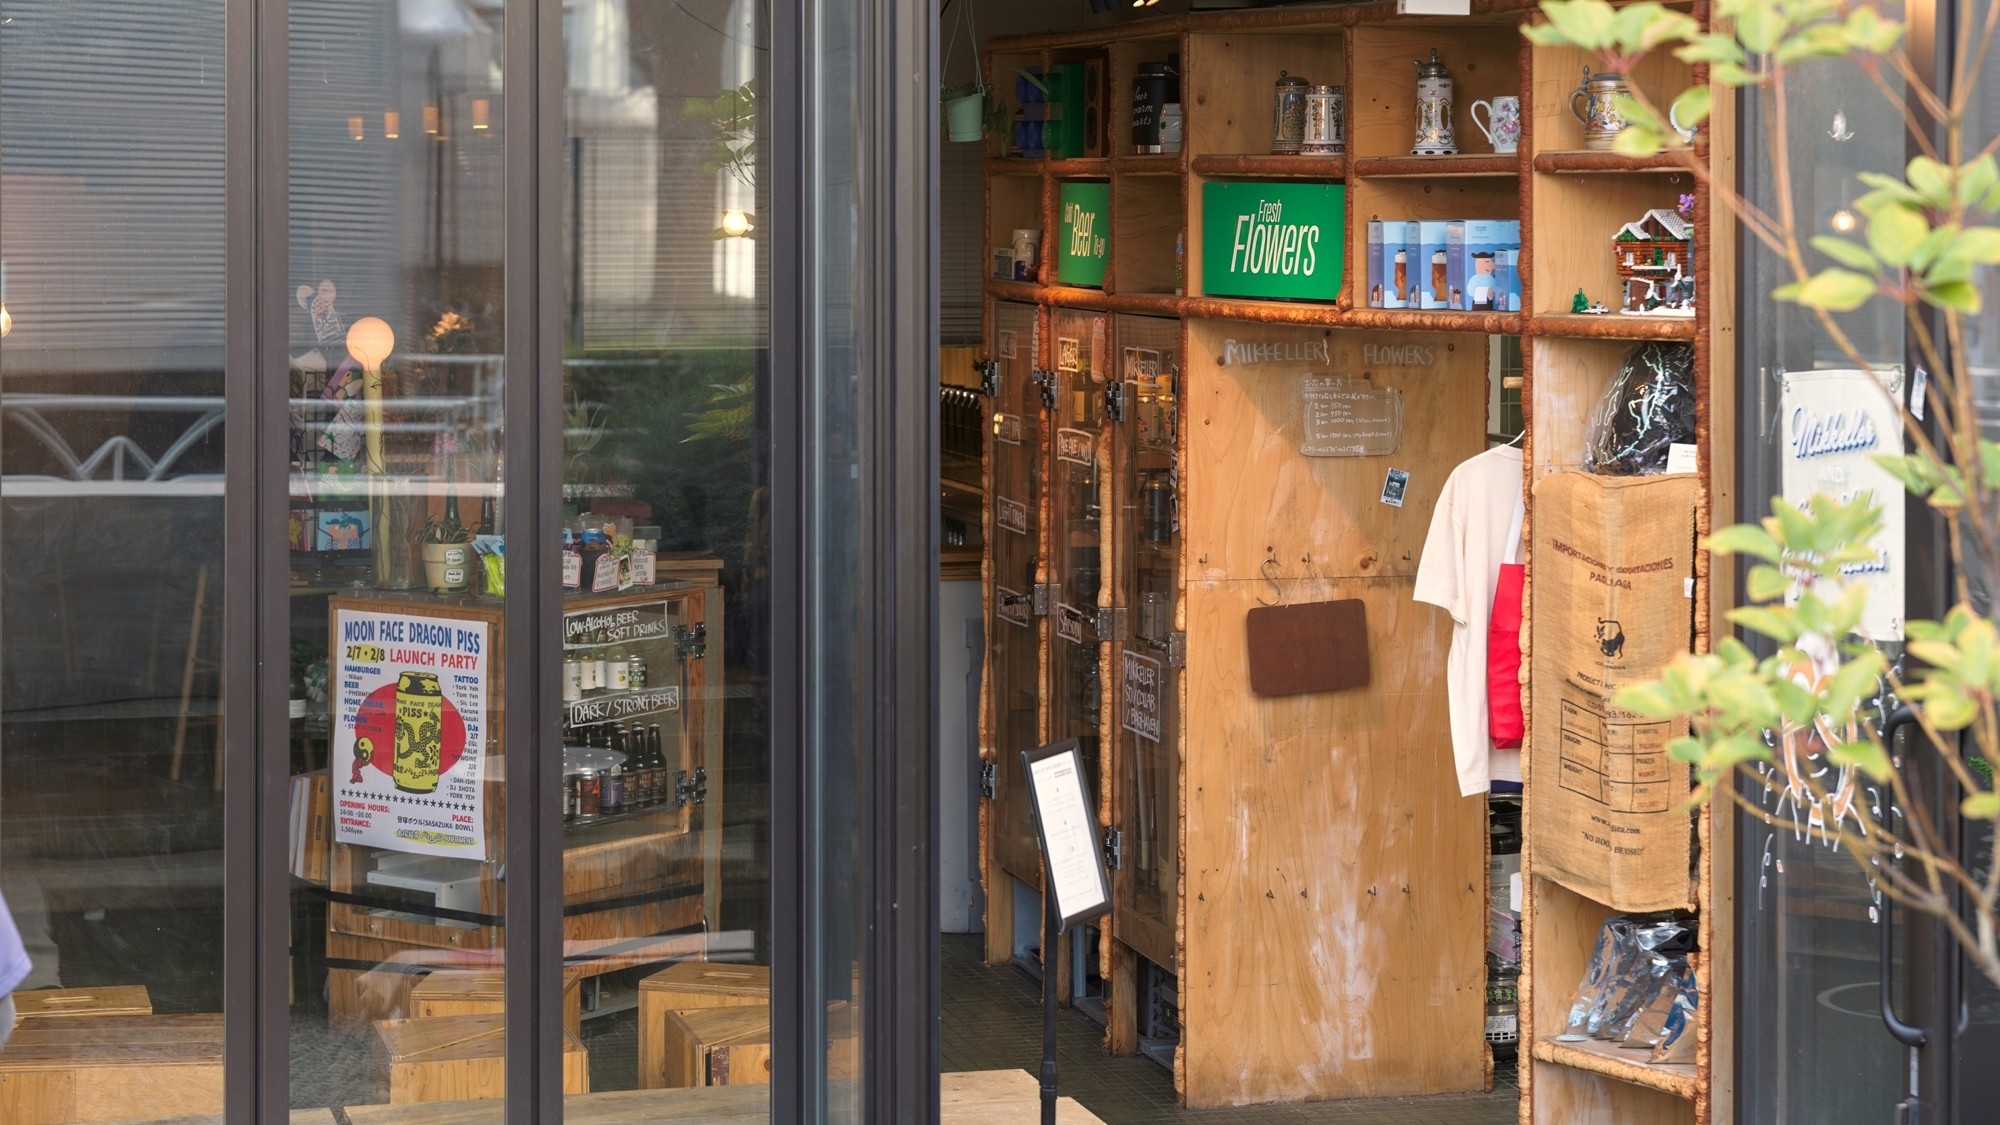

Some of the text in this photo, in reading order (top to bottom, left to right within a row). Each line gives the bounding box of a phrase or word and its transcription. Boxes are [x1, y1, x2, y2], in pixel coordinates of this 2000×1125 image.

[1257, 199, 1282, 222] Fresh
[1070, 204, 1096, 257] Beer
[1230, 213, 1320, 276] Flowers
[1225, 339, 1326, 365] MIKKELLER
[1363, 343, 1434, 366] FLOWERS
[616, 609, 639, 628] BEER
[607, 626, 631, 642] SOFT
[634, 619, 665, 636] DRINKS
[345, 620, 480, 655] MOON FACE DRAGON PISS
[346, 645, 385, 663] 2/7 2/8
[390, 648, 478, 670] LAUNCH PARTY
[344, 665, 381, 675] HAMBURGER
[344, 681, 359, 689] BEER
[453, 675, 479, 684] TATTOO
[344, 698, 361, 706] HOME
[574, 703, 605, 723] DARK
[614, 695, 650, 716] STRONG
[651, 691, 677, 710] BEER
[403, 707, 423, 718] PISS
[461, 715, 479, 723] Kazuki
[467, 724, 479, 732] DJs
[470, 732, 479, 740] 2/7
[339, 800, 390, 813] OPENING HOURS:
[340, 817, 372, 828] ENTRANCE:
[451, 814, 474, 824] PLACE:
[454, 823, 475, 833] BOWL)
